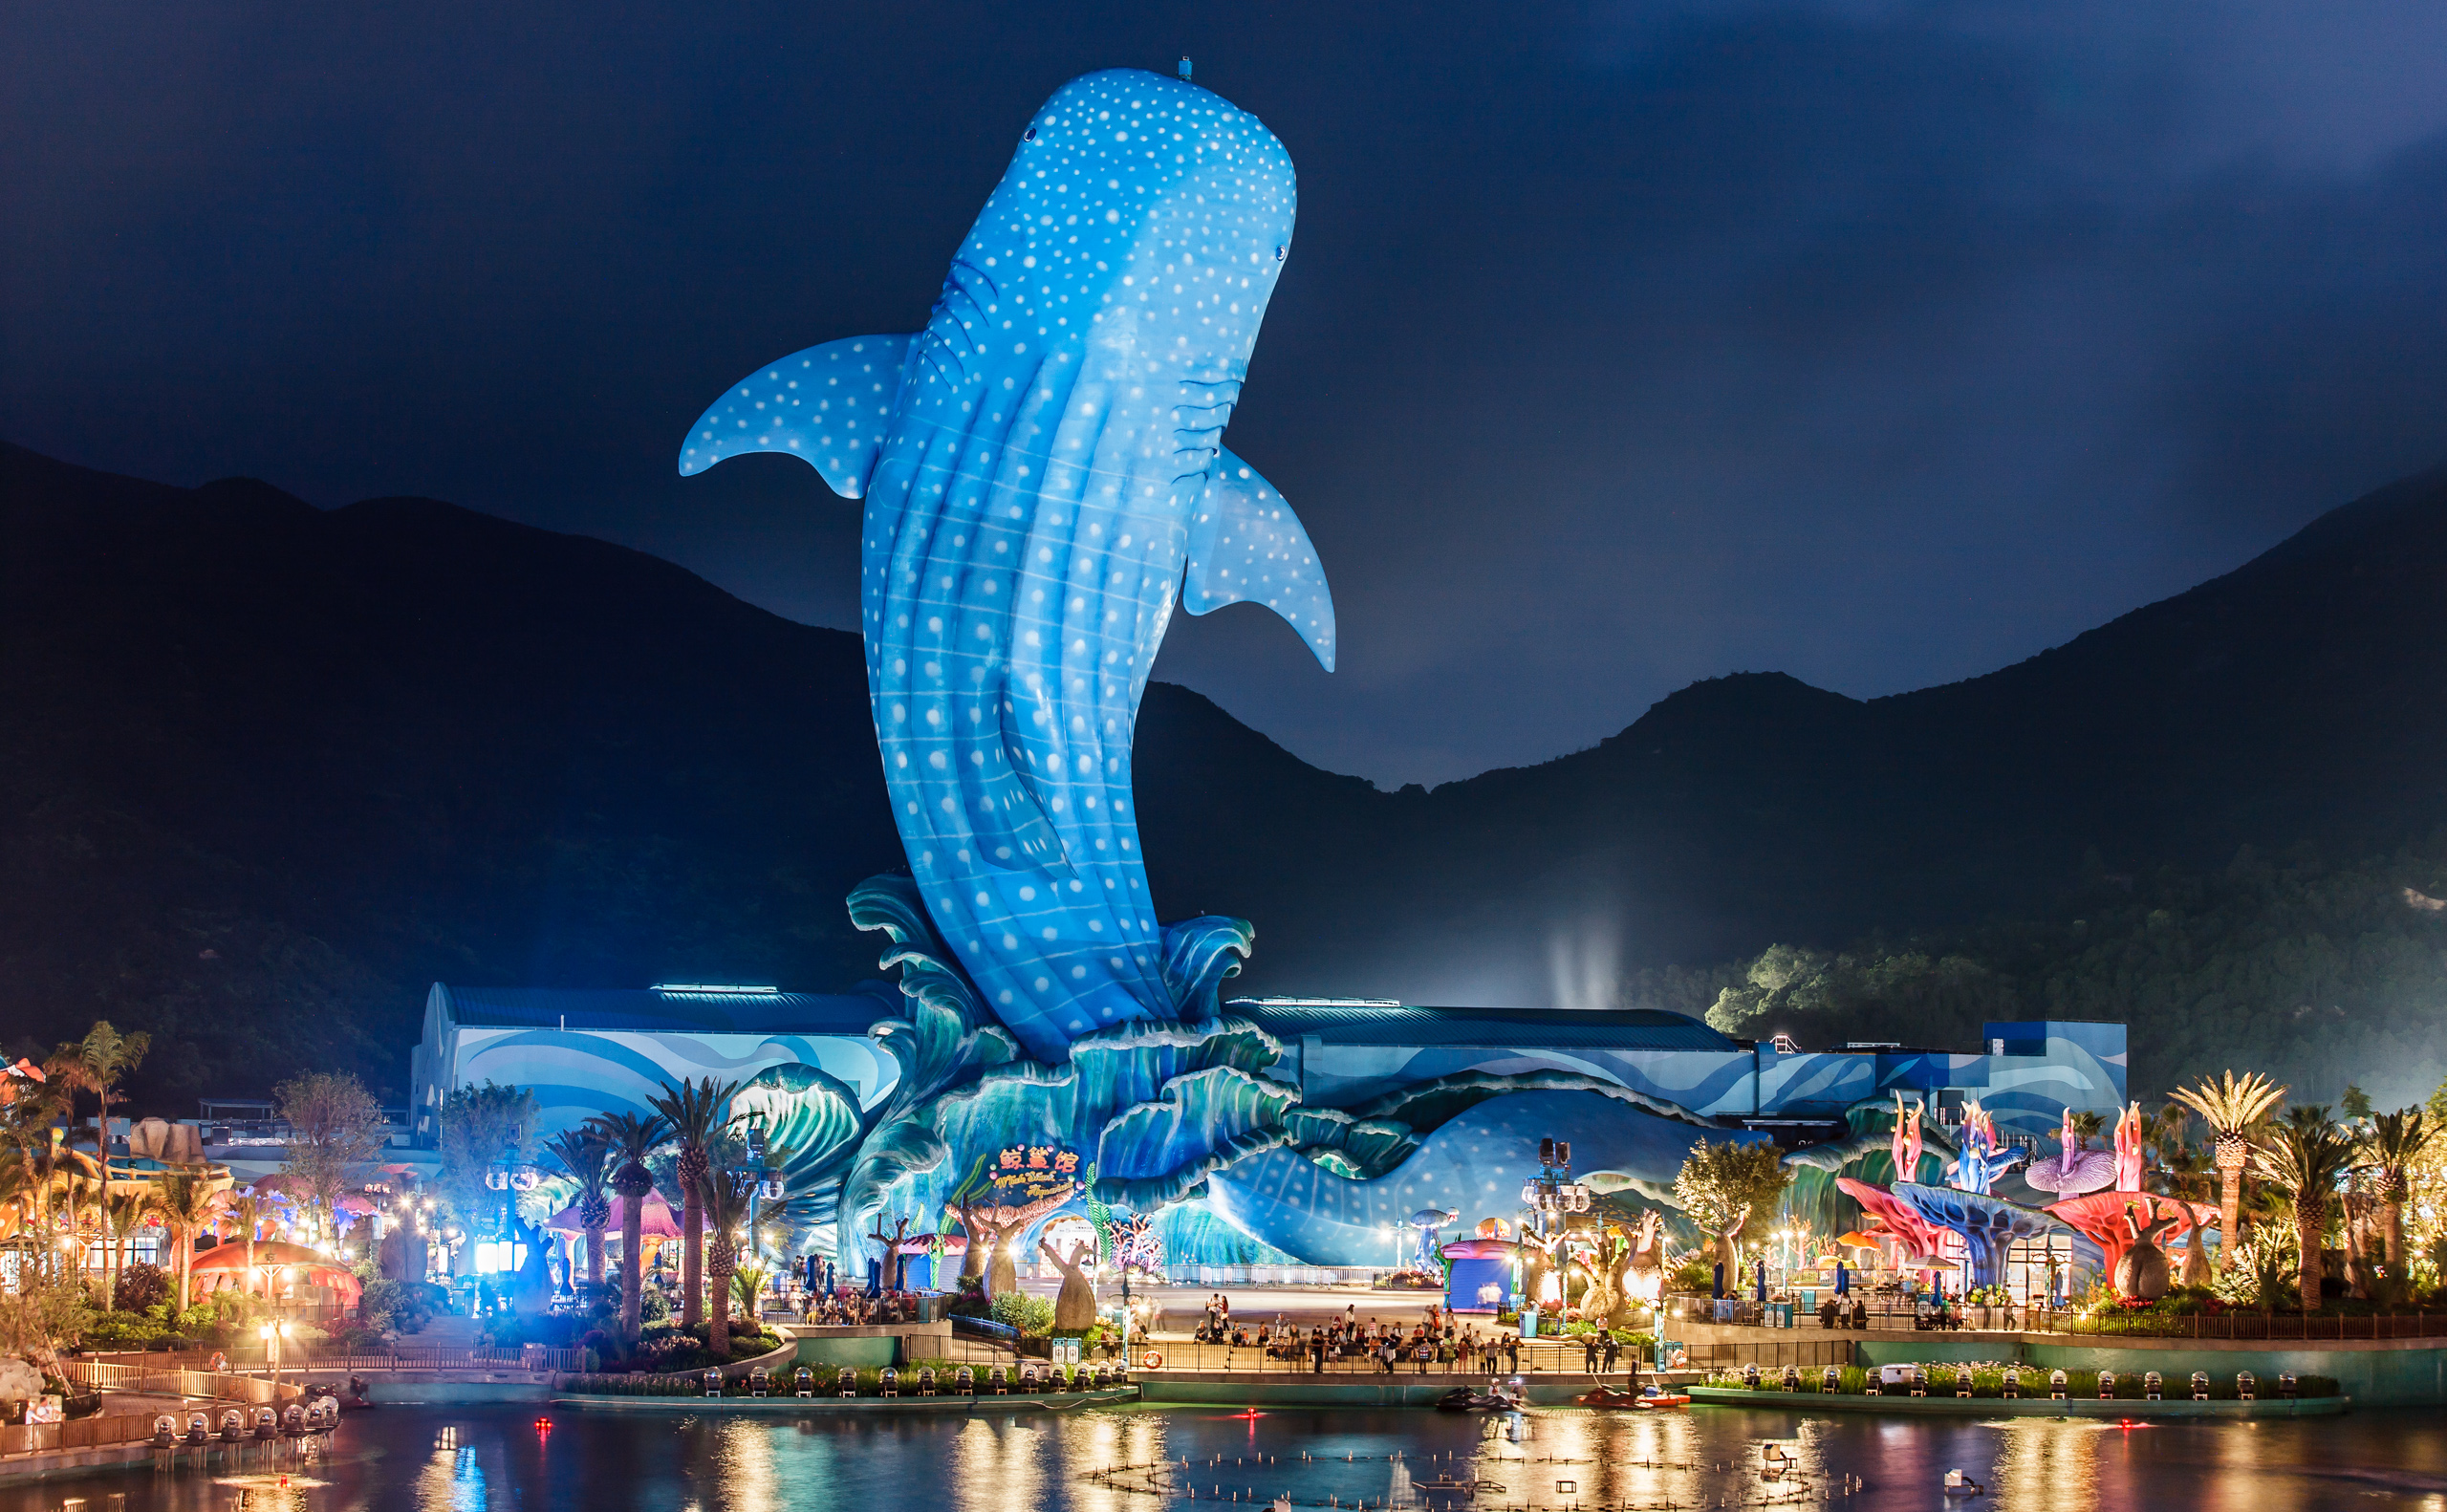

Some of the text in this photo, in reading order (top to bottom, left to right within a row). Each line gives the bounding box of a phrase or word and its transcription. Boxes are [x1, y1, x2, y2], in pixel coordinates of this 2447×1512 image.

[1000, 1146, 1079, 1173] 鲸鲨馆
[1025, 1171, 1056, 1181] Shark
[1027, 1181, 1073, 1199] Aquarium
